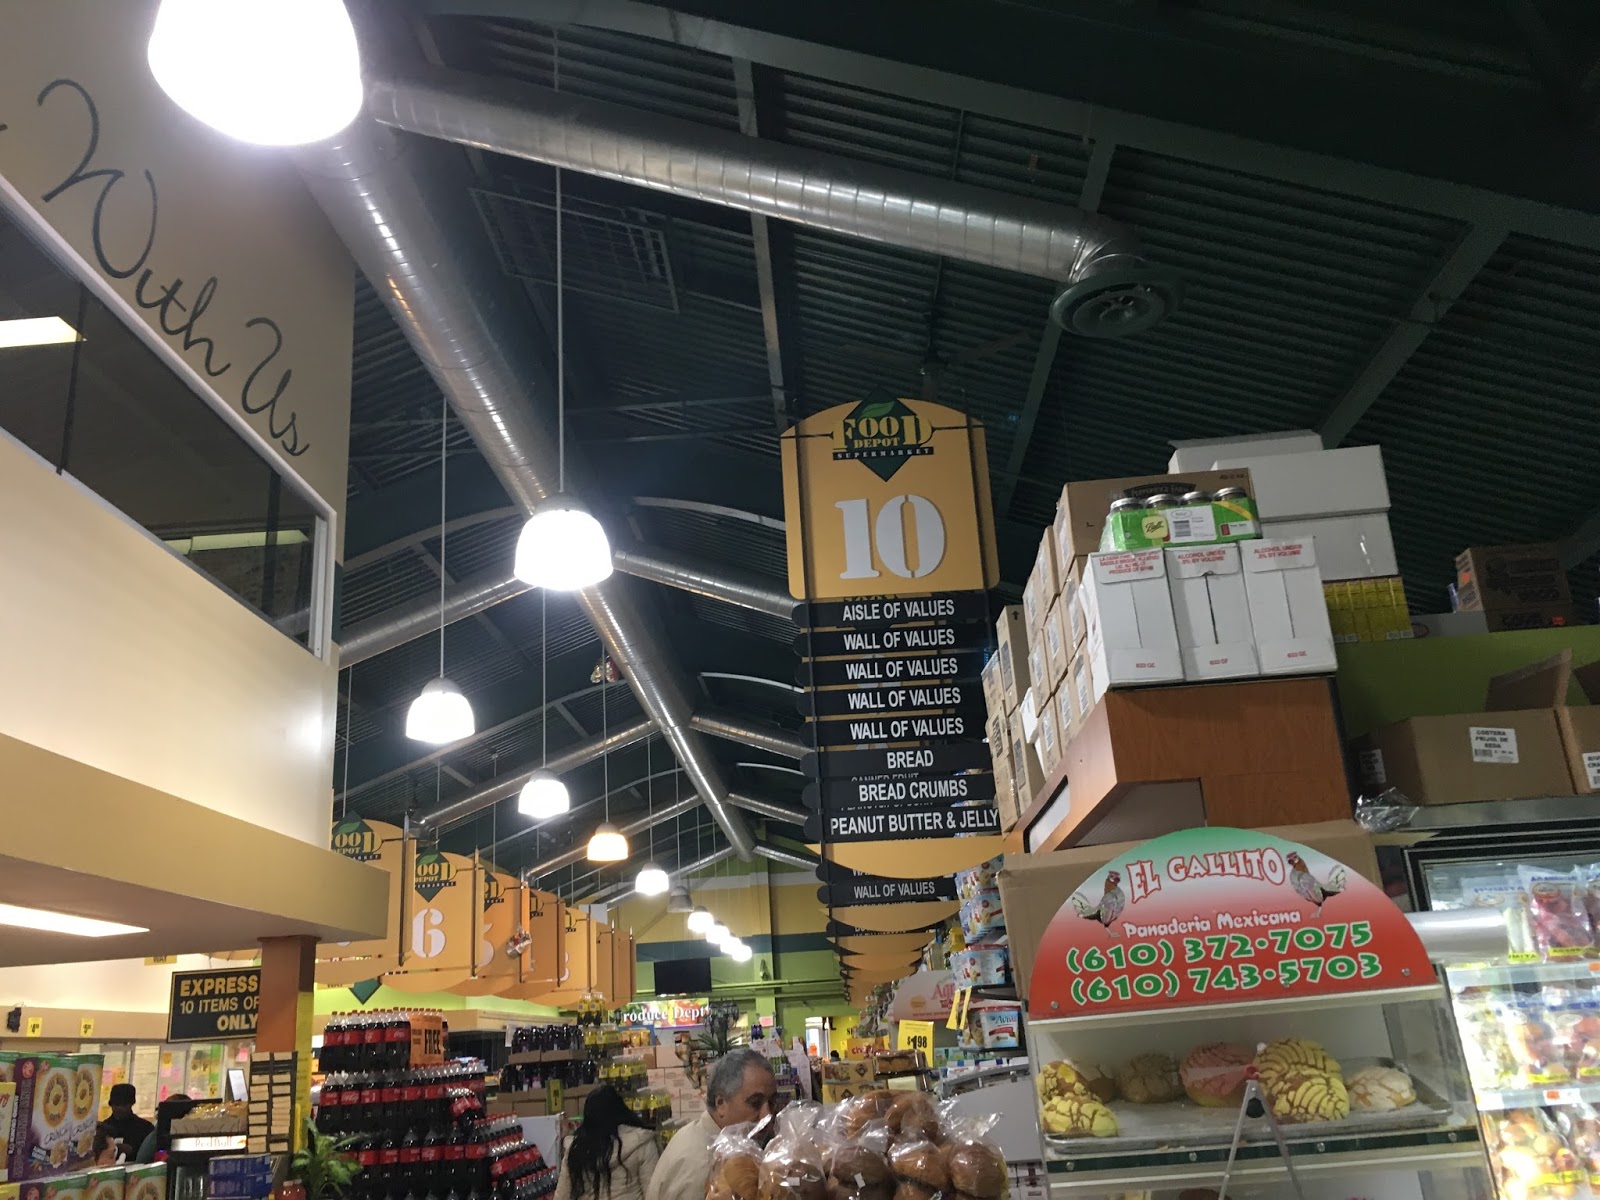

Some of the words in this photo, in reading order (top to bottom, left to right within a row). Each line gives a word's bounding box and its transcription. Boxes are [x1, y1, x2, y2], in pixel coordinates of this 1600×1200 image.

[38, 79, 230, 376] With
[241, 317, 310, 456] Us
[832, 414, 933, 451] FOOD
[854, 438, 900, 448] DEPOT
[837, 449, 931, 458] SUPERMARKET
[835, 495, 945, 579] 10
[842, 603, 880, 621] AISLE
[883, 602, 901, 618] OF
[904, 599, 955, 618] VALUES
[843, 633, 880, 650] WALL
[883, 632, 901, 648] OF
[904, 628, 955, 647] VALUES
[846, 662, 883, 680] WALL
[886, 661, 903, 677] OF
[907, 658, 958, 676] VALUES
[848, 692, 885, 709] WALL
[888, 690, 906, 706] OF
[909, 687, 961, 706] VALUES
[850, 722, 888, 740] WALL
[890, 721, 909, 737] OF
[911, 717, 964, 736] VALUES
[887, 750, 934, 769] BREAD
[858, 783, 906, 802] BREAD
[909, 779, 968, 799] CRUMBS
[830, 817, 884, 836] PEANUT
[889, 812, 943, 832] BUTTER
[946, 811, 957, 829] &
[960, 808, 999, 828] JELLY
[331, 831, 382, 853] OOD
[417, 862, 457, 881] OOD
[1127, 859, 1162, 904] EL
[1167, 847, 1287, 886] GALLITO
[853, 886, 880, 899] WALL
[883, 884, 896, 897] OF
[898, 881, 935, 896] VALUES
[412, 908, 446, 958] 6
[1123, 919, 1211, 938] Panaderia
[1216, 910, 1301, 930] Mexicana
[1065, 938, 1175, 975] (610)
[179, 975, 258, 997] EXPRESS
[1070, 969, 1180, 1006] (610)
[179, 1000, 194, 1014] 10
[198, 1000, 239, 1013] ITEMS
[622, 1009, 669, 1022] roduce
[216, 1014, 258, 1032] ONLY
